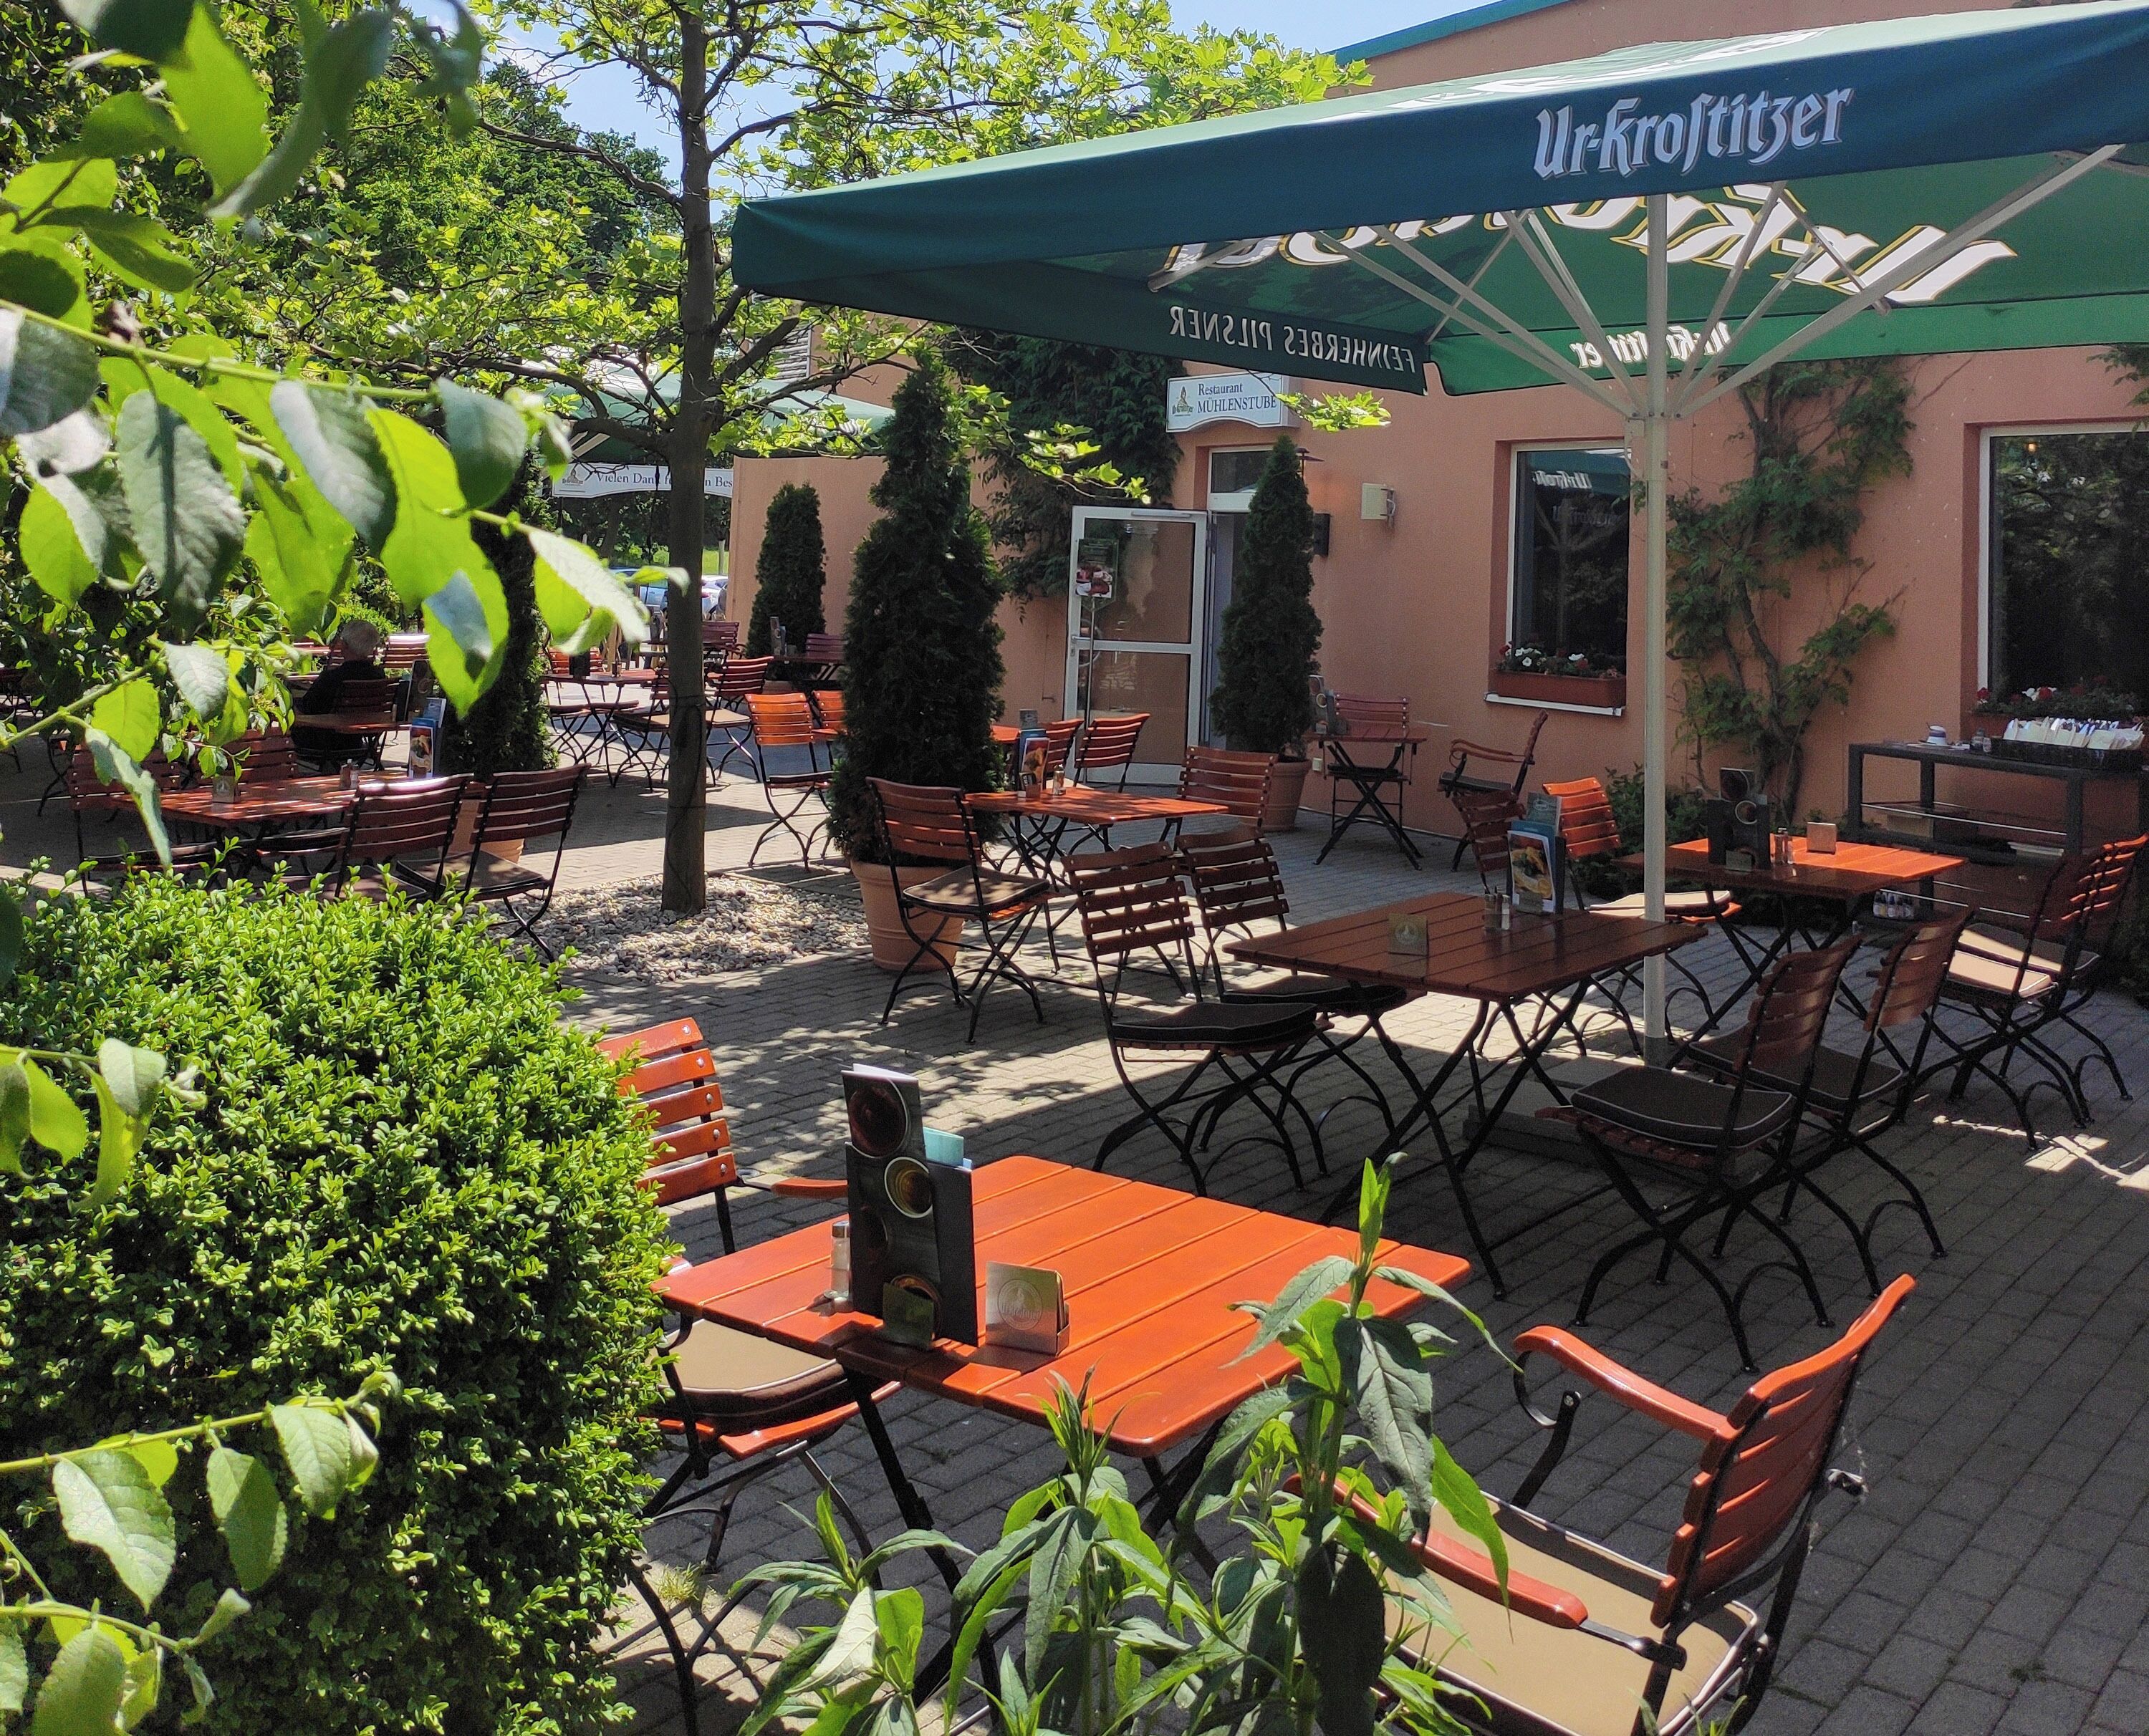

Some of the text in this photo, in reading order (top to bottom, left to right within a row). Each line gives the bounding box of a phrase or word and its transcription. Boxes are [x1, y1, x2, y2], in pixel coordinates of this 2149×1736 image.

[1198, 383, 1243, 396] Restaurant
[1197, 395, 1277, 413] MÜHLENSTUBE
[597, 473, 629, 483] Vielen
[633, 473, 660, 484] Dan
